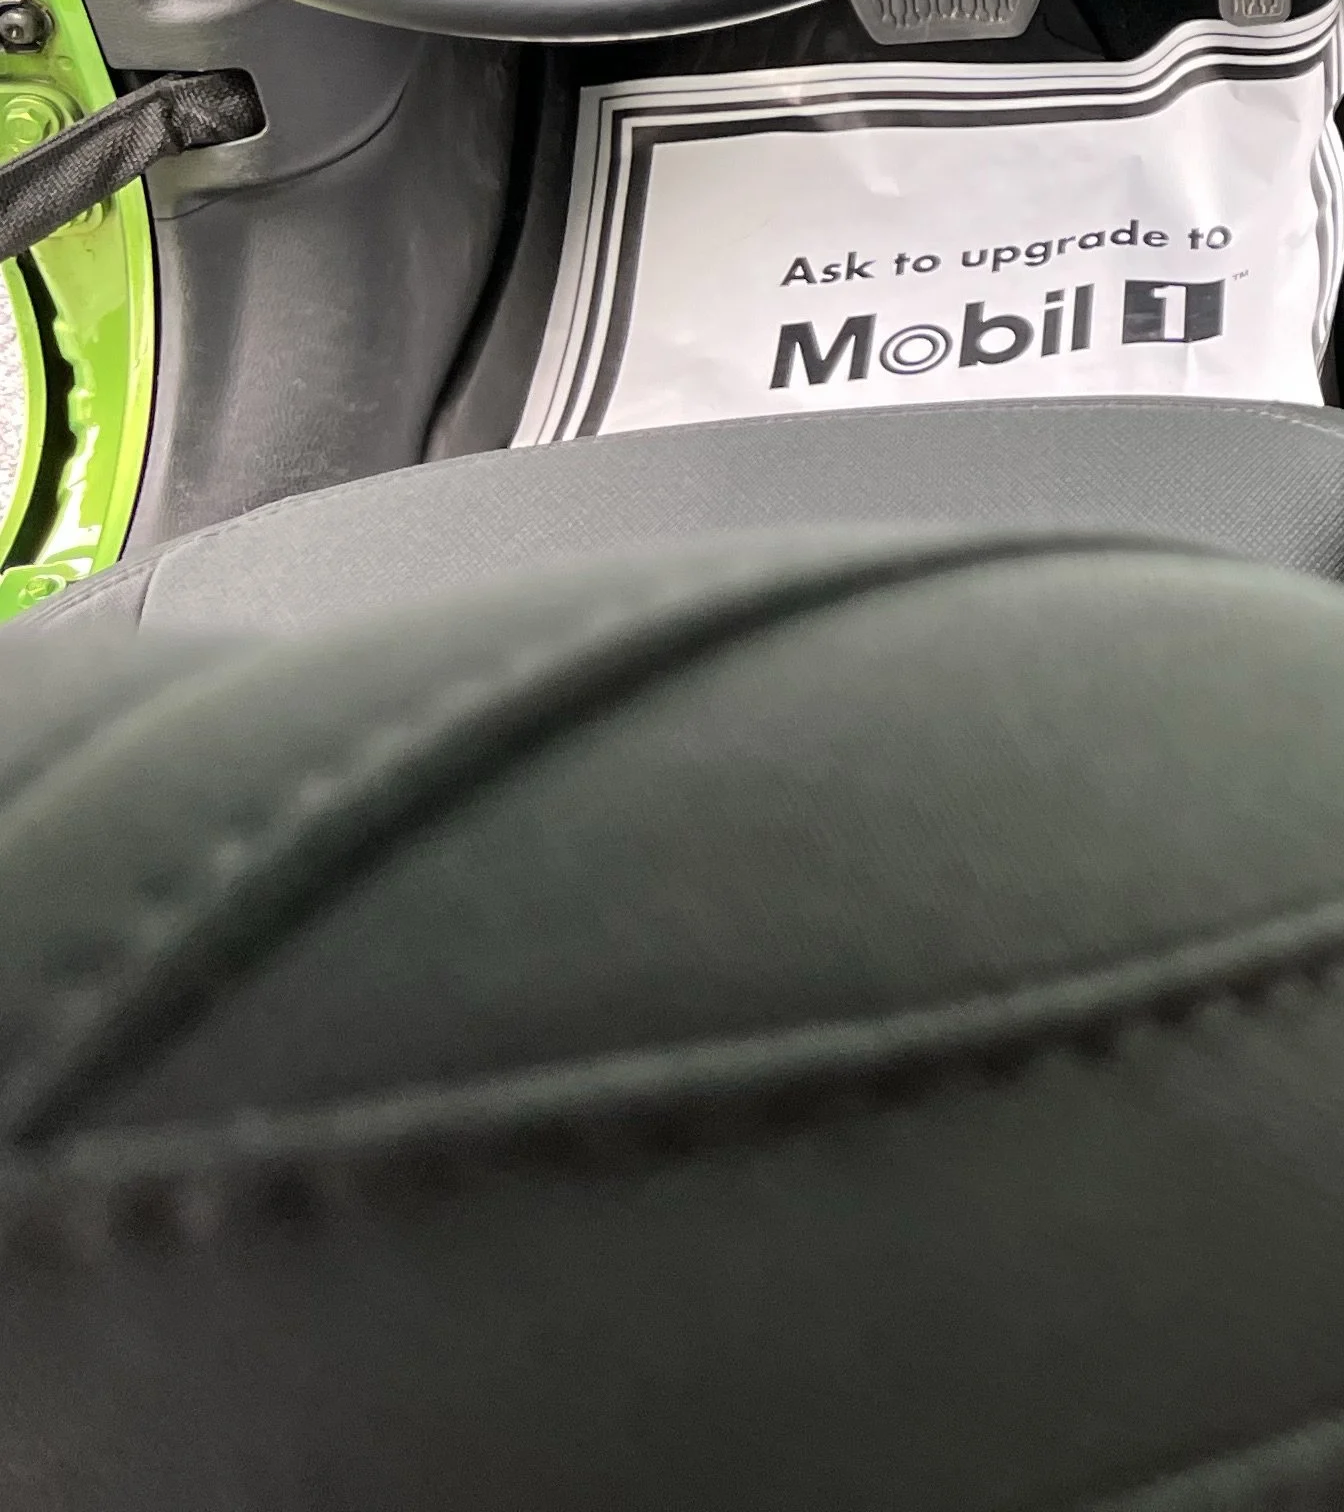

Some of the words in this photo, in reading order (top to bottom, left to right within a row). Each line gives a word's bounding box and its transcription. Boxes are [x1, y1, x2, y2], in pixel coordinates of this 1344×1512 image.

[779, 251, 875, 287] Ask
[894, 252, 941, 277] to
[961, 219, 1170, 273] upgrade
[1188, 224, 1233, 251] to
[769, 283, 1095, 389] Mobil
